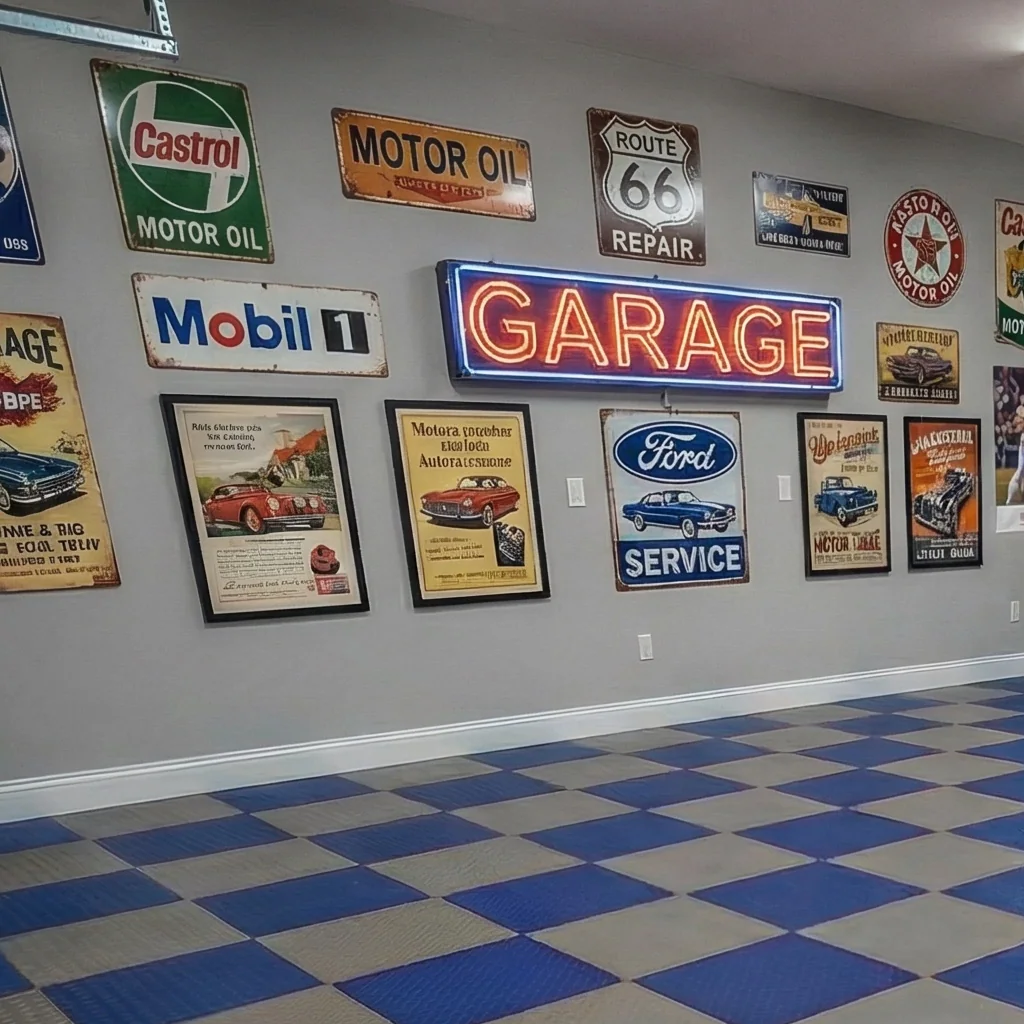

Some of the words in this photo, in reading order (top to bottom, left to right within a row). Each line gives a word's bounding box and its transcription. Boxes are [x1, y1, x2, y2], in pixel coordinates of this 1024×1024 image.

[134, 121, 240, 170] Castrol
[349, 125, 468, 180] MOTOR
[479, 146, 528, 187] OIL
[615, 131, 677, 157] ROUTE
[619, 162, 681, 215] 66
[137, 215, 220, 248] MOTOR
[226, 225, 264, 252] OIL
[612, 229, 694, 260] REPAIR
[940, 272, 958, 295] OIL
[152, 296, 313, 352] Mobil
[333, 312, 355, 352] 1
[469, 280, 835, 379] GARAGE
[0, 327, 64, 371] AGE
[638, 430, 716, 473] Ford
[625, 544, 742, 578] SERVICE
